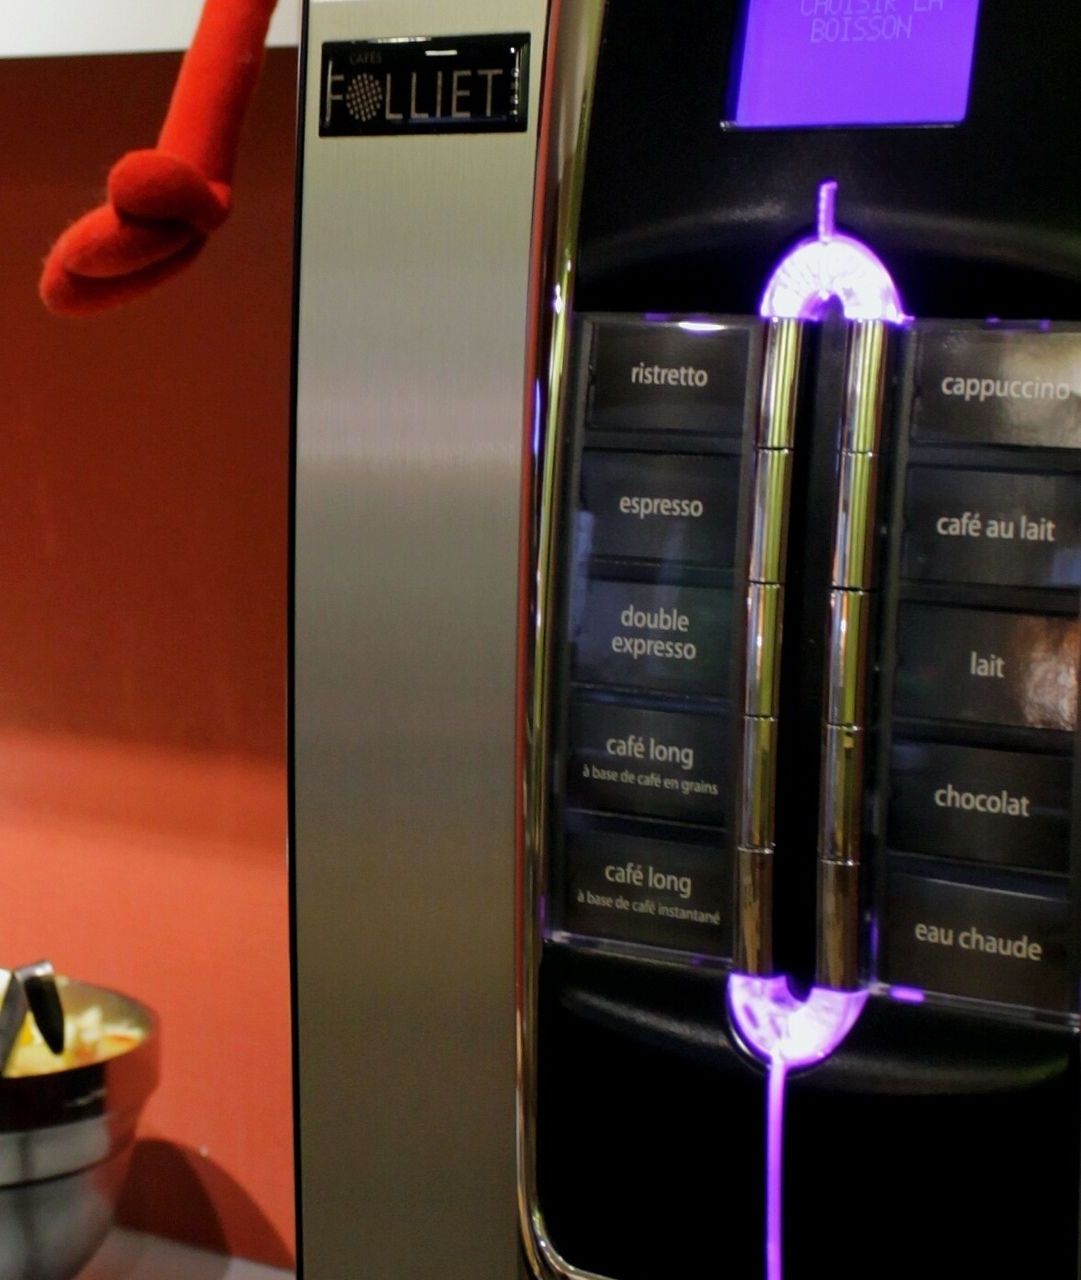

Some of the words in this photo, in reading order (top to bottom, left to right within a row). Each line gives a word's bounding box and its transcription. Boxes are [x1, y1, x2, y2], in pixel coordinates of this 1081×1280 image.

[810, 15, 912, 43] BOISSON
[326, 69, 504, 122] FOLLIET
[631, 362, 708, 387] ristretto
[941, 376, 1071, 402] cappuccino
[620, 496, 703, 519] espresso
[936, 512, 982, 537] café
[986, 520, 1014, 538] au
[1021, 515, 1056, 541] lait
[621, 605, 689, 632] double
[612, 636, 696, 660] expresso
[970, 652, 1005, 679] lait
[606, 735, 645, 758] café
[650, 737, 694, 770] long
[582, 764, 590, 778] à
[592, 765, 618, 782] base
[620, 770, 635, 784] de
[637, 772, 662, 788] café
[664, 777, 679, 790] en
[681, 780, 719, 795] grains
[934, 785, 1030, 816] chocolat
[604, 862, 644, 887] café
[648, 866, 692, 899] long
[577, 889, 585, 903] à
[586, 890, 613, 907] base
[615, 896, 630, 910] de
[632, 899, 657, 915] café
[658, 902, 721, 925] instantané
[915, 923, 953, 946] eau
[959, 927, 1042, 960] chaude
